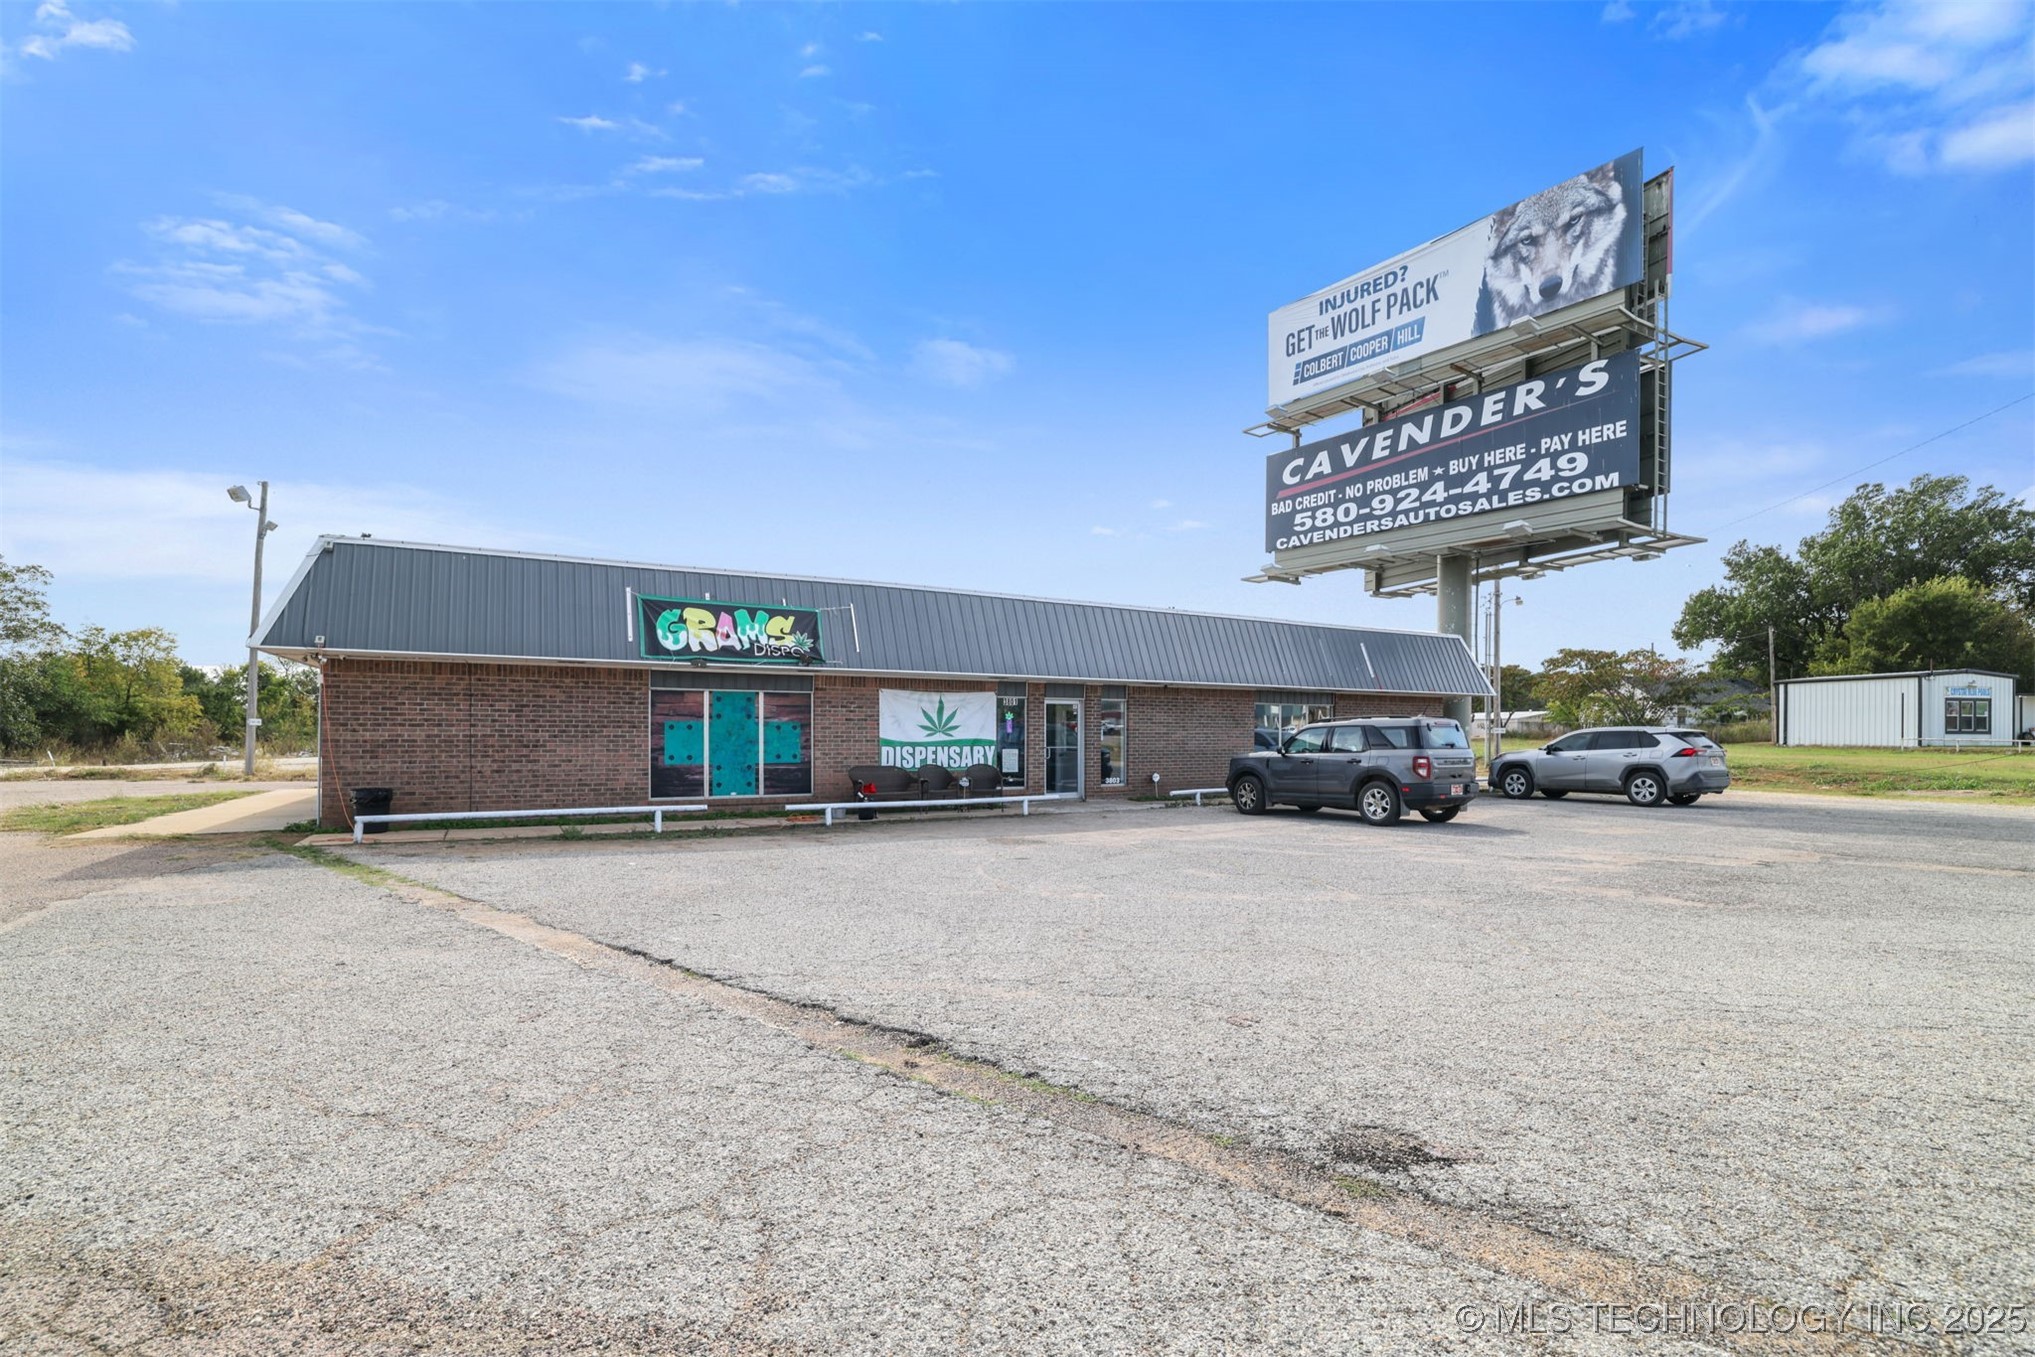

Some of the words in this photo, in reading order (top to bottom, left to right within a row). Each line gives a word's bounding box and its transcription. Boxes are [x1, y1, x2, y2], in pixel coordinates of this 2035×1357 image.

[1319, 265, 1408, 316] INJURED?
[1286, 324, 1315, 357] GET
[1315, 326, 1329, 341] THE
[1330, 298, 1381, 340] WOLF
[1303, 354, 1344, 378] COLBERT
[1350, 335, 1388, 362] COOPER
[1397, 324, 1420, 346] HILL
[1282, 358, 1610, 486] CAVENDER'S
[1271, 499, 1293, 515] BAD
[1295, 491, 1336, 511] CREDIT
[1345, 485, 1363, 500] NO
[1366, 467, 1428, 496] PROBLEM
[1449, 454, 1478, 475] BUY
[1484, 444, 1526, 466] HERE
[1540, 433, 1571, 455] PAY
[1577, 420, 1627, 447] HERE
[1293, 451, 1589, 532] 580-924-4749
[1276, 472, 1620, 550] CAVENDERSAUTOSALES.COM
[656, 606, 796, 652] GRAMS
[881, 745, 996, 769] DISPENSARY
